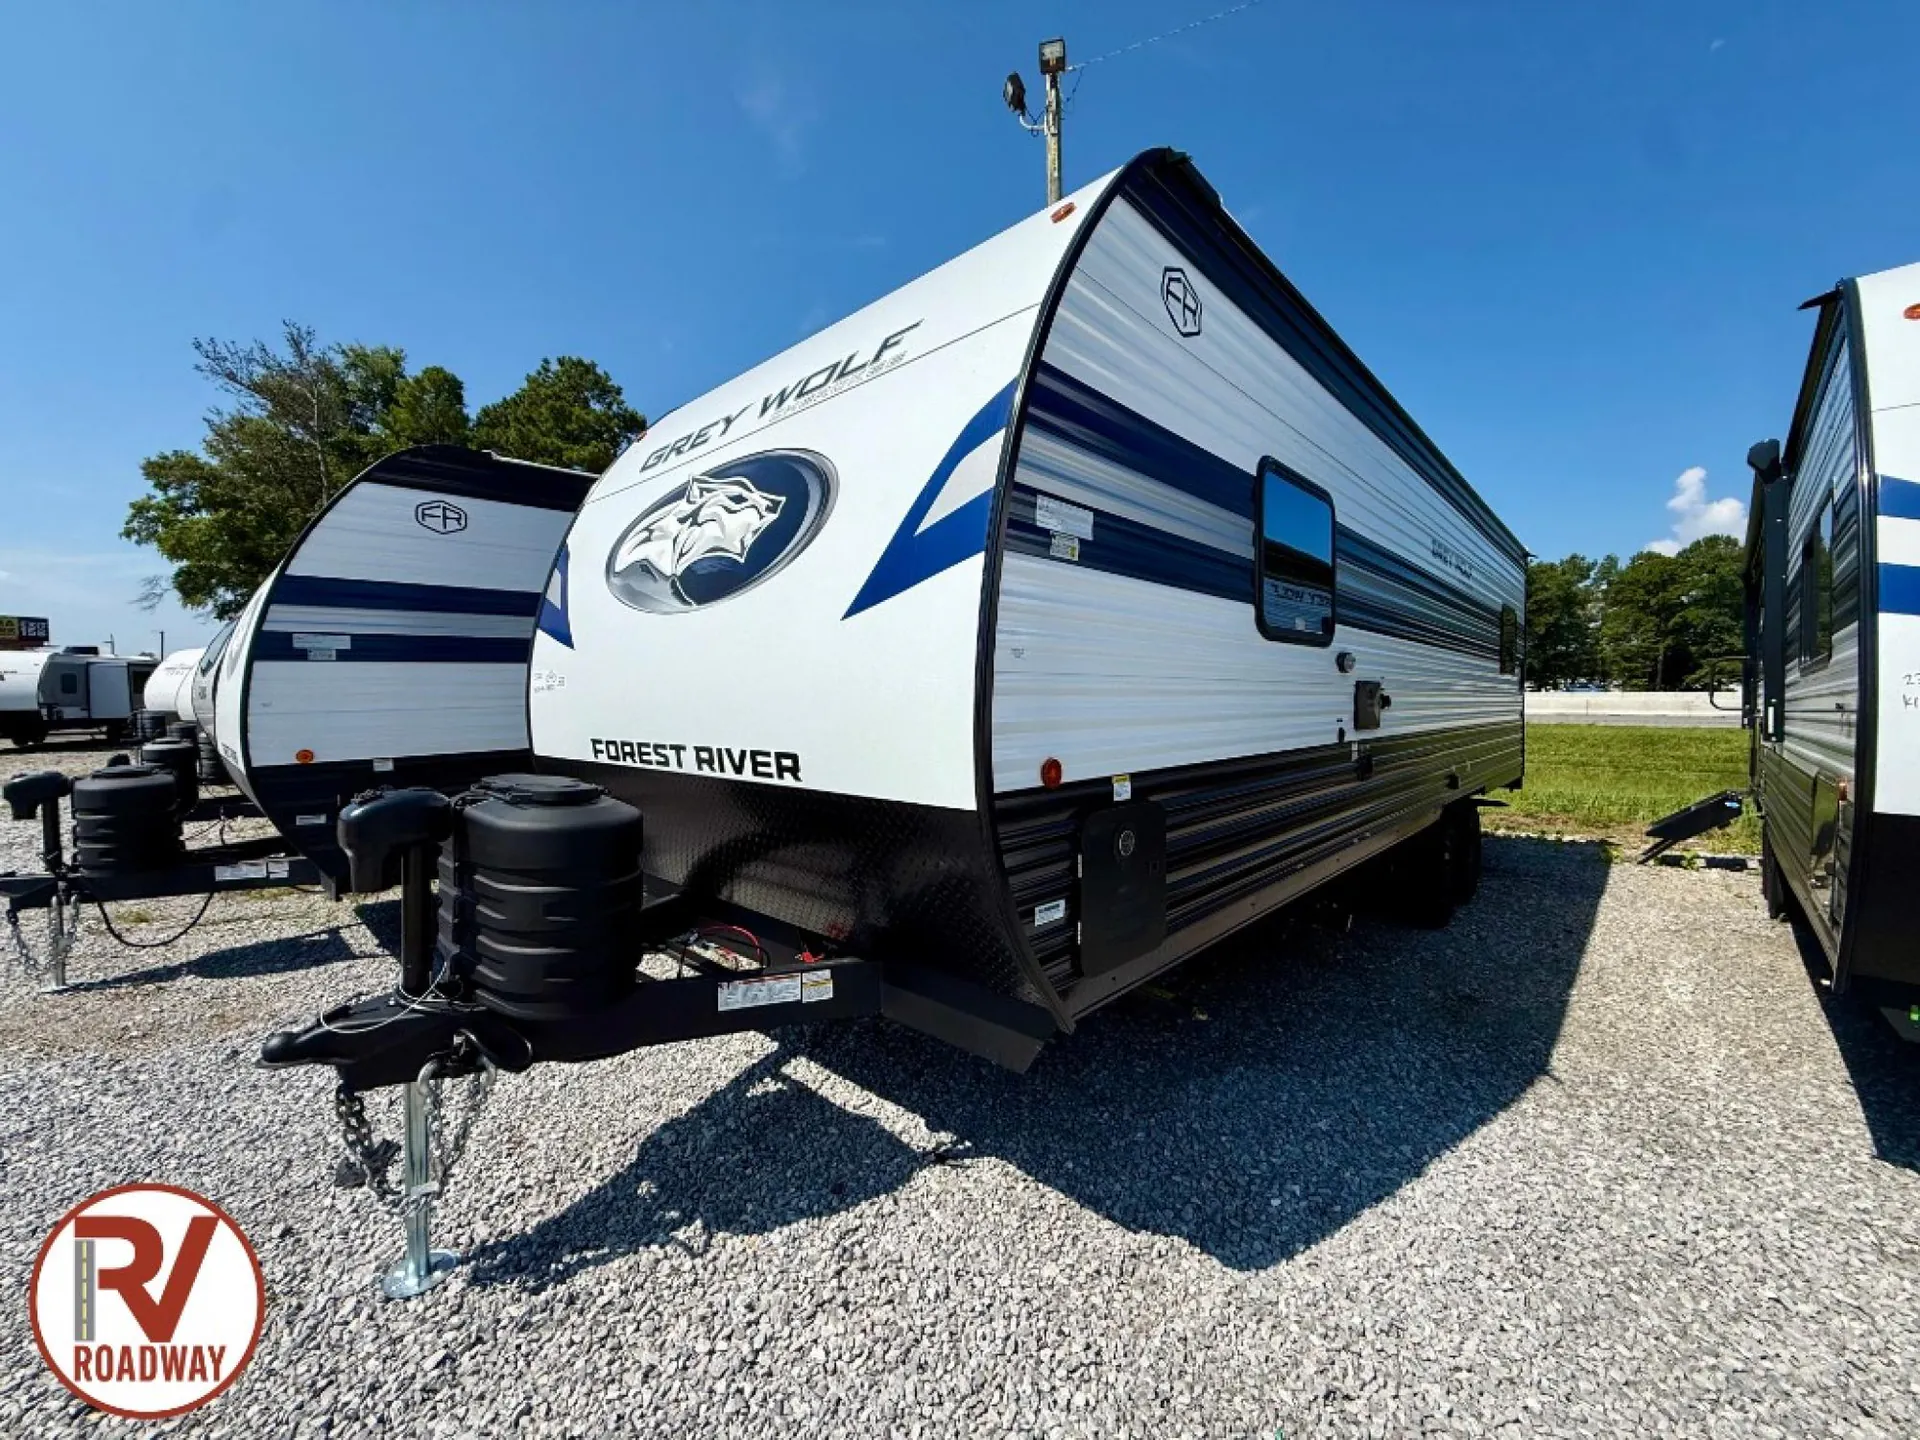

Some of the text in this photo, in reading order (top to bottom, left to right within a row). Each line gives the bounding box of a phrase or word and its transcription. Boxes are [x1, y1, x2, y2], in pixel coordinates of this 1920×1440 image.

[640, 402, 755, 473] GREY
[758, 318, 925, 419] WOLF
[421, 504, 462, 529] FR
[590, 738, 803, 782] FOREST RIVER
